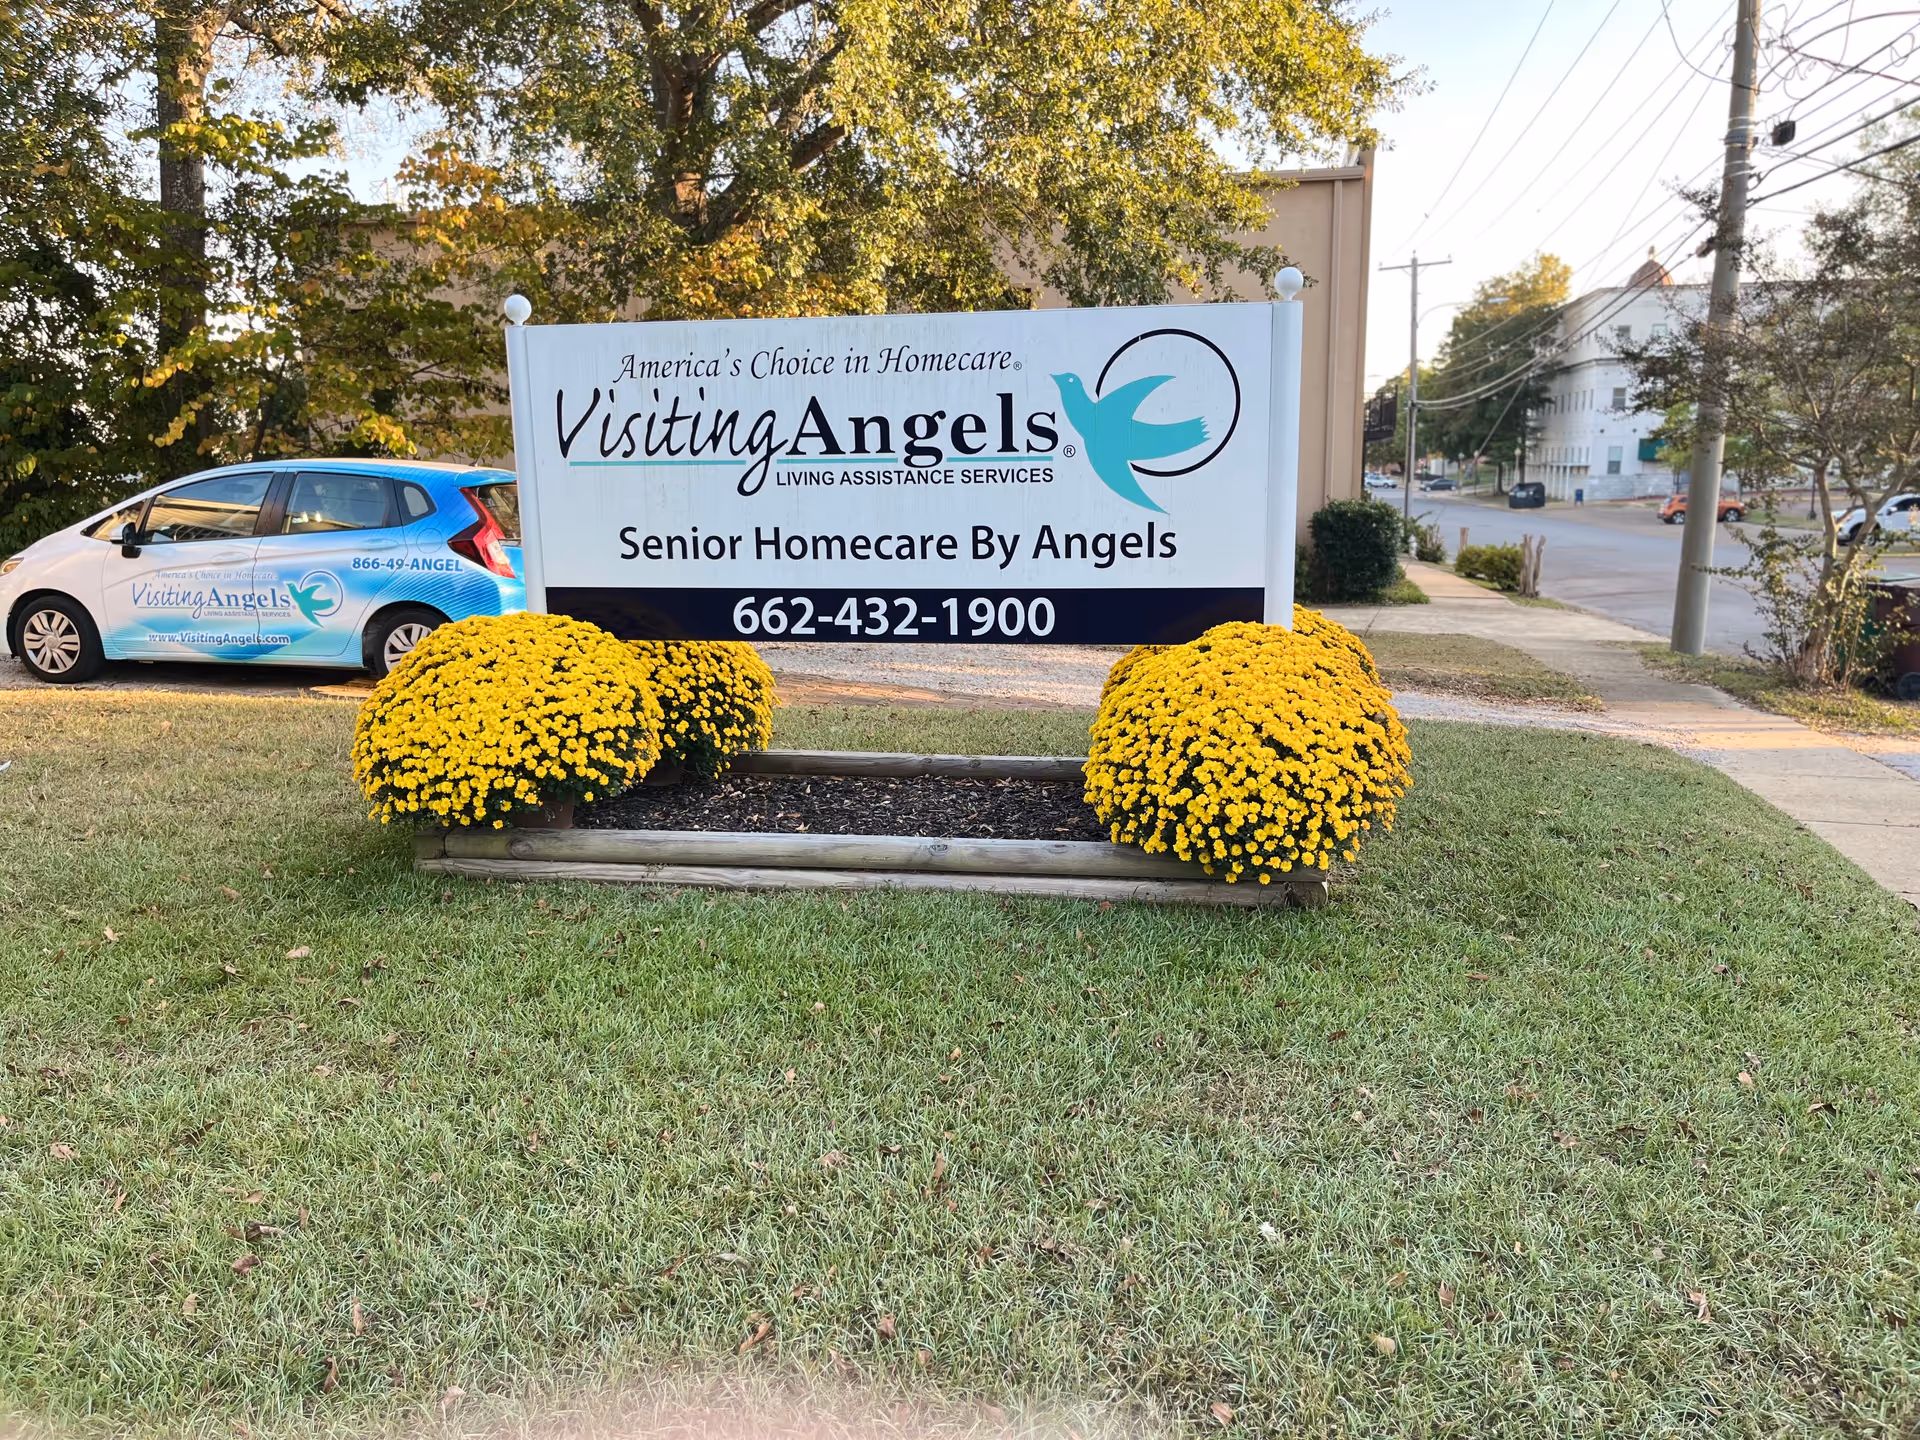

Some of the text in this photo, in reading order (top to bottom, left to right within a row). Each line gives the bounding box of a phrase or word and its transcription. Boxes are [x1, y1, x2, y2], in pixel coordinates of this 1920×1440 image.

[613, 348, 742, 383] America's
[750, 346, 835, 380] Choice
[844, 347, 871, 374] in
[776, 468, 1054, 486] LIVING ASSISTANCE SERVICES
[619, 521, 1178, 569] Senior Homecare By Angels
[352, 557, 464, 573] 866-49-ANGEL
[733, 596, 1056, 637] 662-432-1900
[148, 632, 290, 646] www.VisitingAngels.com
